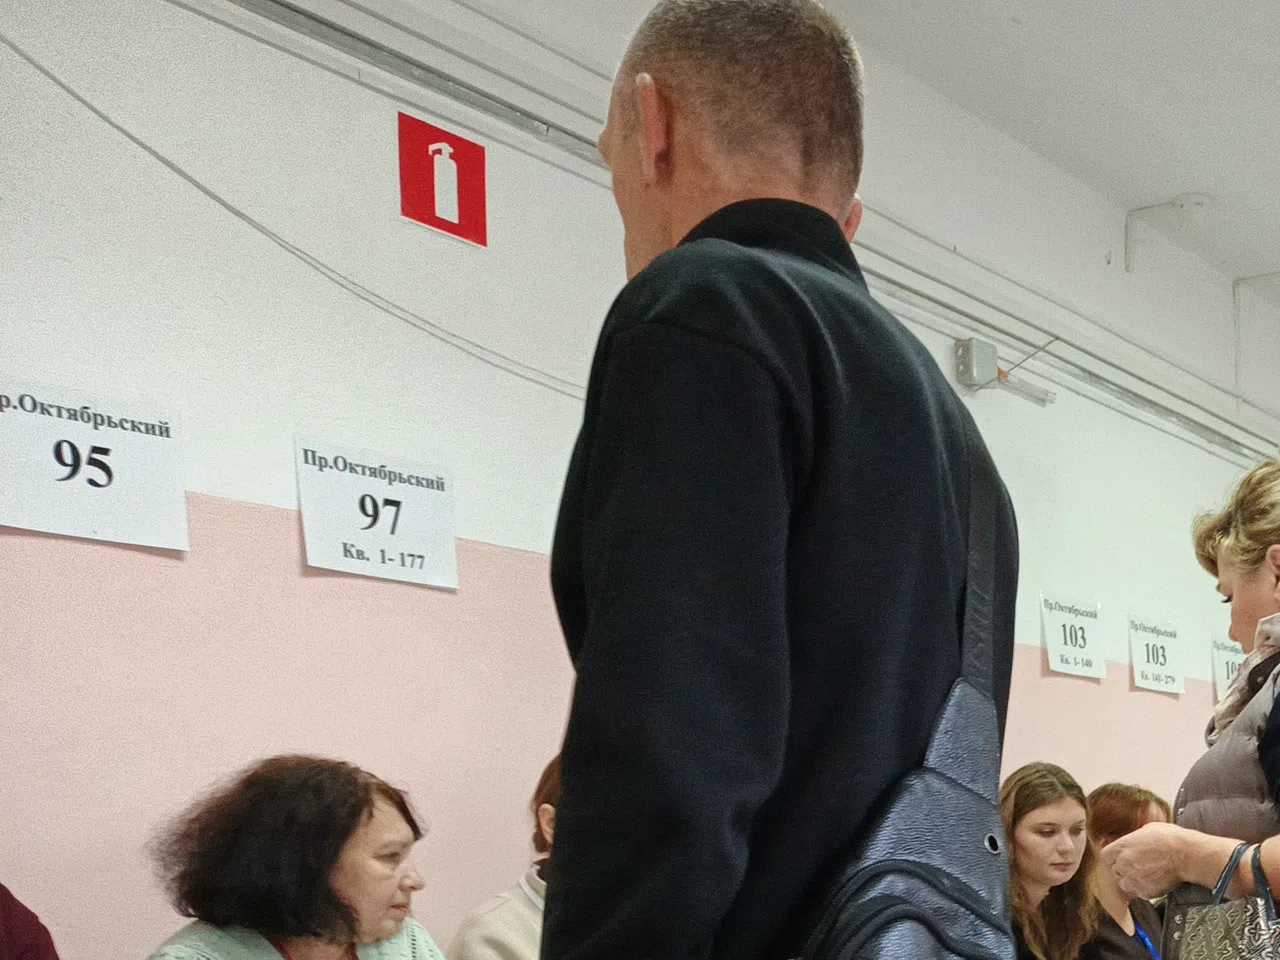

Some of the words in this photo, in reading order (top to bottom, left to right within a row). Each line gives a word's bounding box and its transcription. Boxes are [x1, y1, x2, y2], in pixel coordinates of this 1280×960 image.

[0, 394, 172, 438] р.Октябрьский
[53, 439, 114, 488] 95
[301, 448, 446, 492] Пр.Октябрьский
[358, 493, 403, 536] 97
[341, 541, 370, 562] Кв.
[1043, 598, 1098, 619] Пр.Октябрьский
[1062, 623, 1087, 650] 103
[1145, 642, 1167, 667] 103
[1225, 660, 1241, 680] 10
